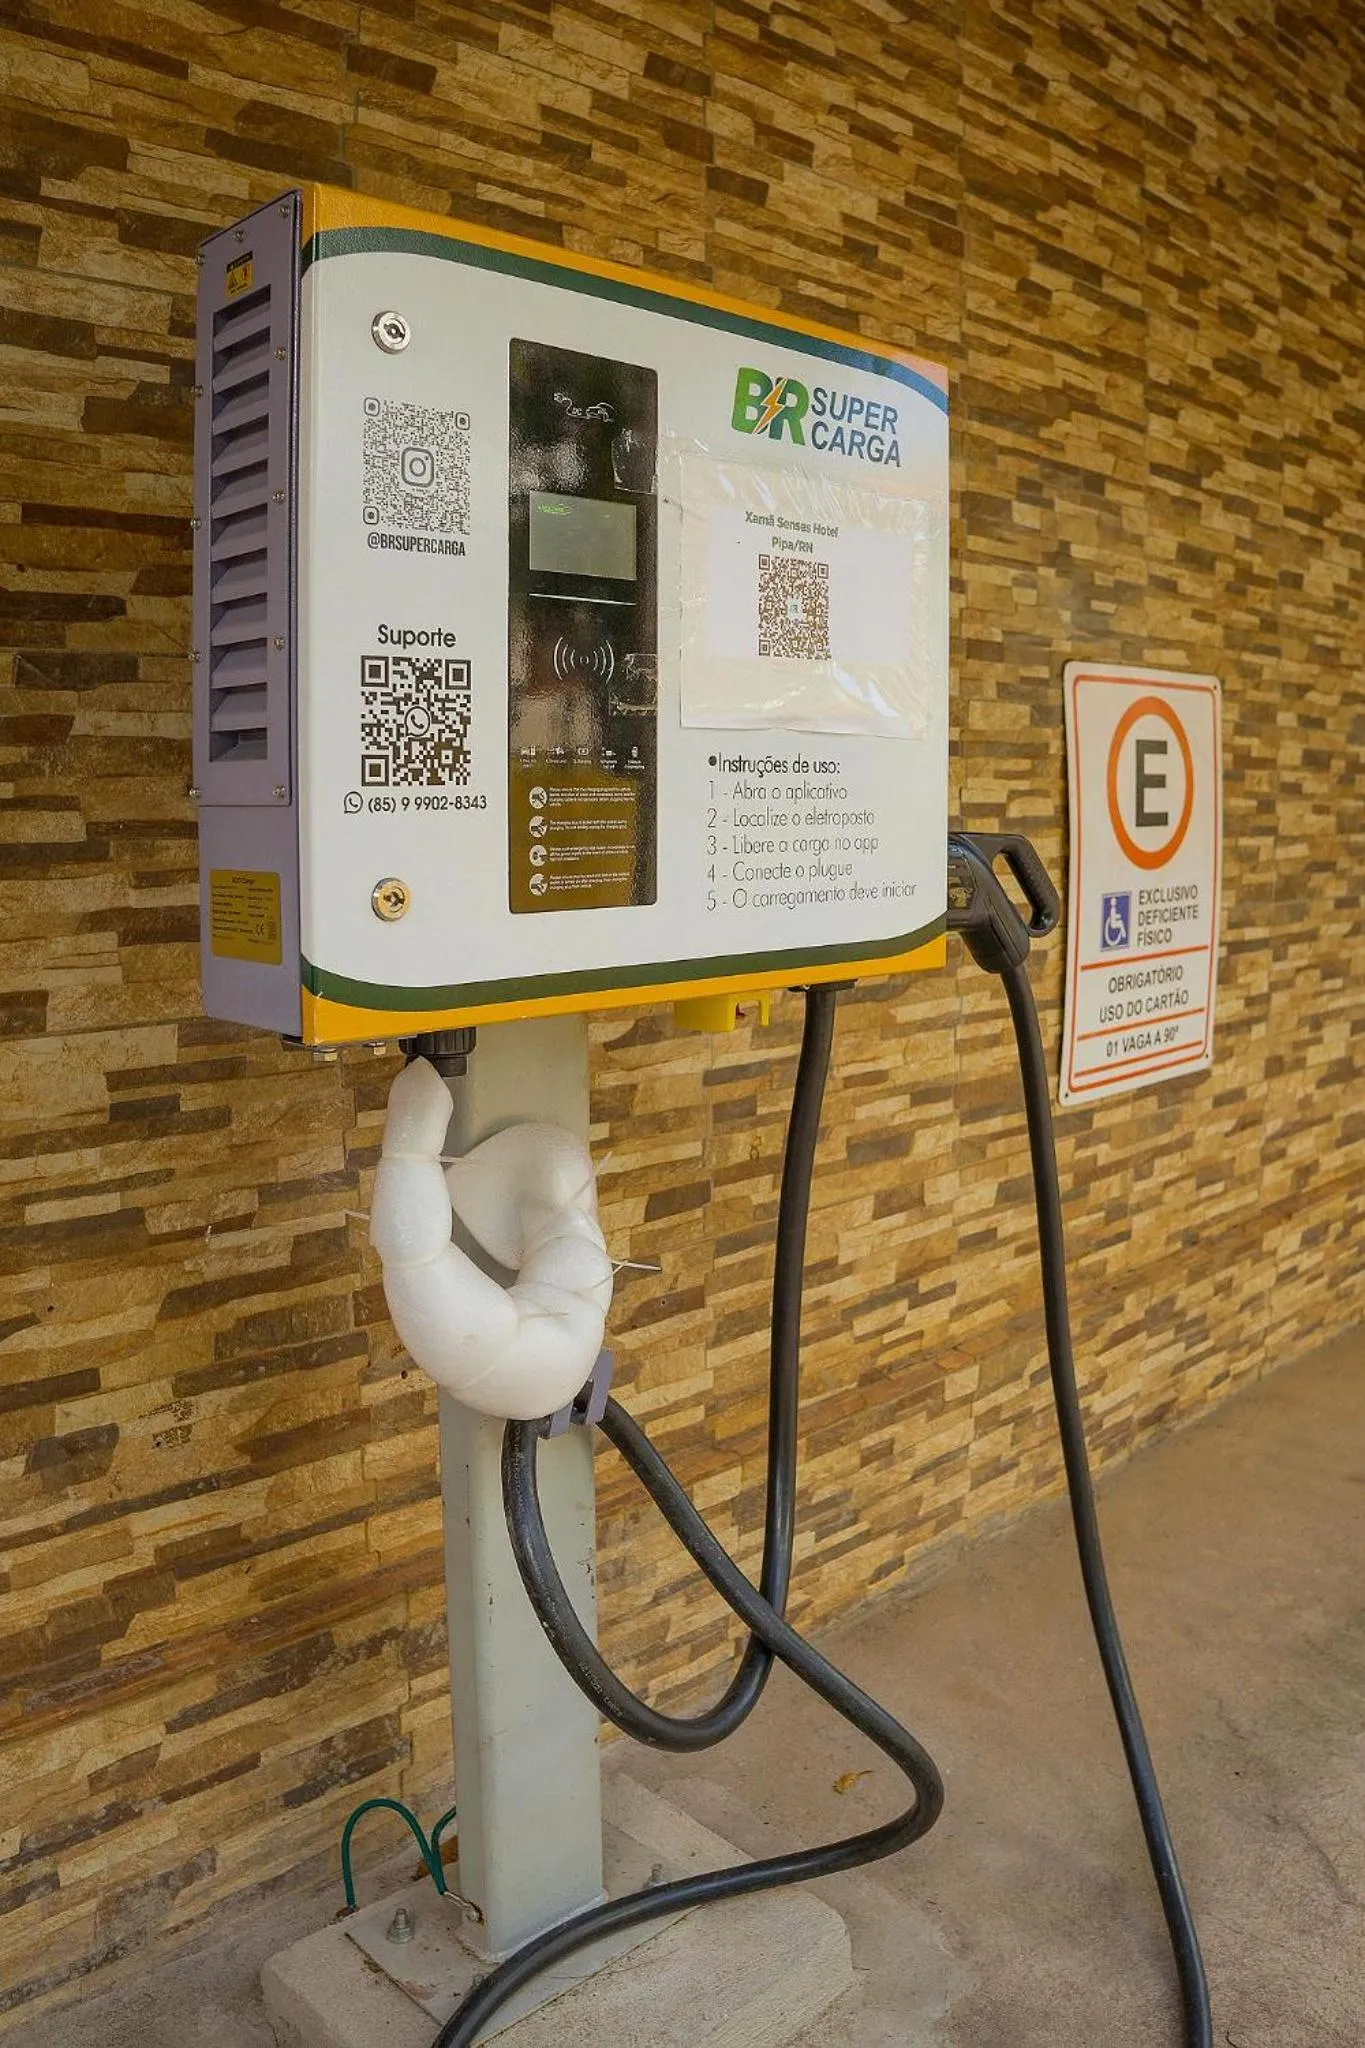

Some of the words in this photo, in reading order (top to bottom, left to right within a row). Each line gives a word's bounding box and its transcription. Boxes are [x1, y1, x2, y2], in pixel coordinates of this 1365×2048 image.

[731, 367, 809, 446] BR
[811, 387, 898, 435] SUPER
[811, 421, 901, 468] CARGA
[777, 517, 811, 533] Senses
[813, 522, 839, 538] Hotel
[367, 531, 466, 557] @BRSUPERCARGA
[772, 536, 813, 553] Pipa/RN
[377, 624, 457, 649] Suporte
[719, 752, 789, 778] Instruções
[792, 753, 809, 773] de
[814, 760, 840, 774] uso:
[732, 780, 766, 800] Abra
[772, 787, 781, 799] o
[786, 780, 847, 804] aplicativo
[1136, 739, 1168, 827] E
[368, 796, 397, 814] (85)
[402, 796, 410, 812] 9
[414, 795, 487, 811] 9902-8343
[707, 808, 717, 828] 2
[733, 806, 788, 827] Localize
[792, 813, 801, 826] o
[805, 806, 875, 829] eletroposto
[707, 835, 717, 855] 3
[733, 834, 774, 854] Libere
[779, 840, 788, 853] a
[792, 838, 829, 856] carga
[835, 838, 850, 850] no
[854, 837, 879, 855] app
[707, 864, 715, 882] 4
[732, 861, 791, 882] Conecte
[795, 865, 805, 878] o
[808, 858, 853, 882] plugue
[707, 890, 716, 911] 5
[732, 888, 747, 908] O
[752, 887, 845, 910] carregamento
[850, 881, 878, 901] deve
[882, 880, 917, 898] iniciar
[1138, 884, 1198, 905] EXCLUSIVO
[1138, 904, 1199, 927] DEFICIENTE
[1137, 927, 1172, 946] FÍSICO
[1108, 965, 1184, 994] OBRIGATÓRIO
[1100, 1003, 1123, 1024] USO
[1126, 1000, 1142, 1018] DO
[1145, 989, 1189, 1014] CARTÃO
[1106, 1040, 1118, 1057] 01
[1122, 1032, 1152, 1053] VAGA
[1154, 1029, 1161, 1046] A
